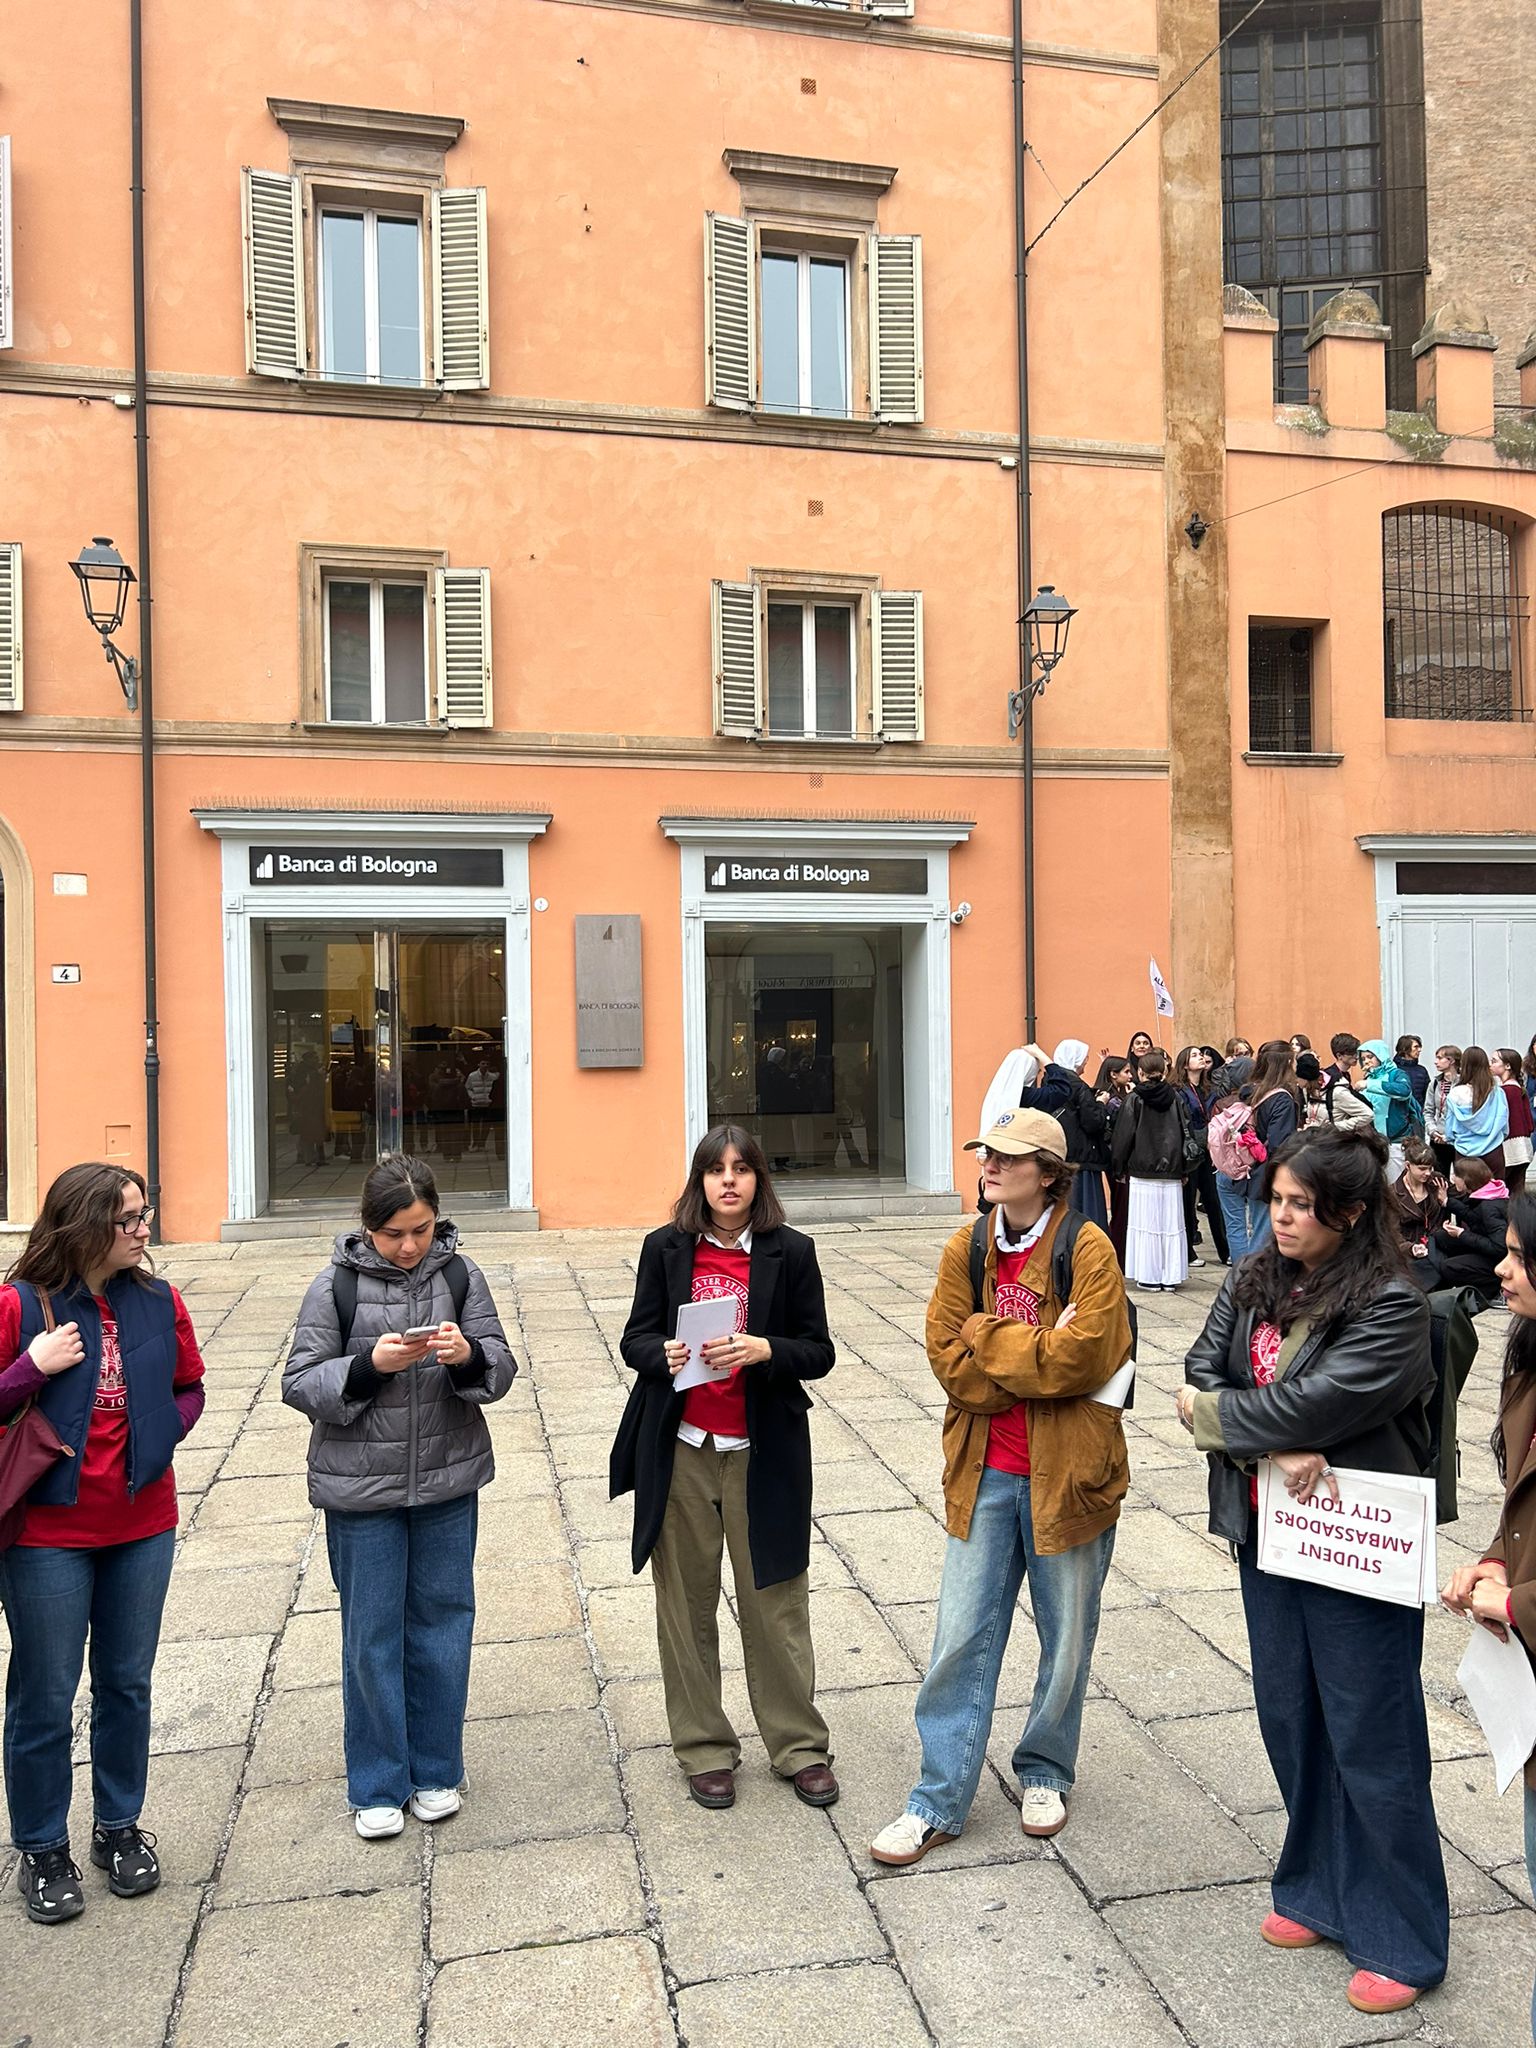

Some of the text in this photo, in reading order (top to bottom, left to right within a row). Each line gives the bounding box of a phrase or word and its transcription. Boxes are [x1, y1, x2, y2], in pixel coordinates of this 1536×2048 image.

[279, 855, 438, 877] Banca di Bologna
[731, 863, 870, 885] Banca di Bologna
[60, 968, 70, 981] 4
[1350, 1503, 1393, 1524] CITY
[1274, 1510, 1414, 1555] AMBASSADORS
[1297, 1541, 1383, 1574] STUDENT
